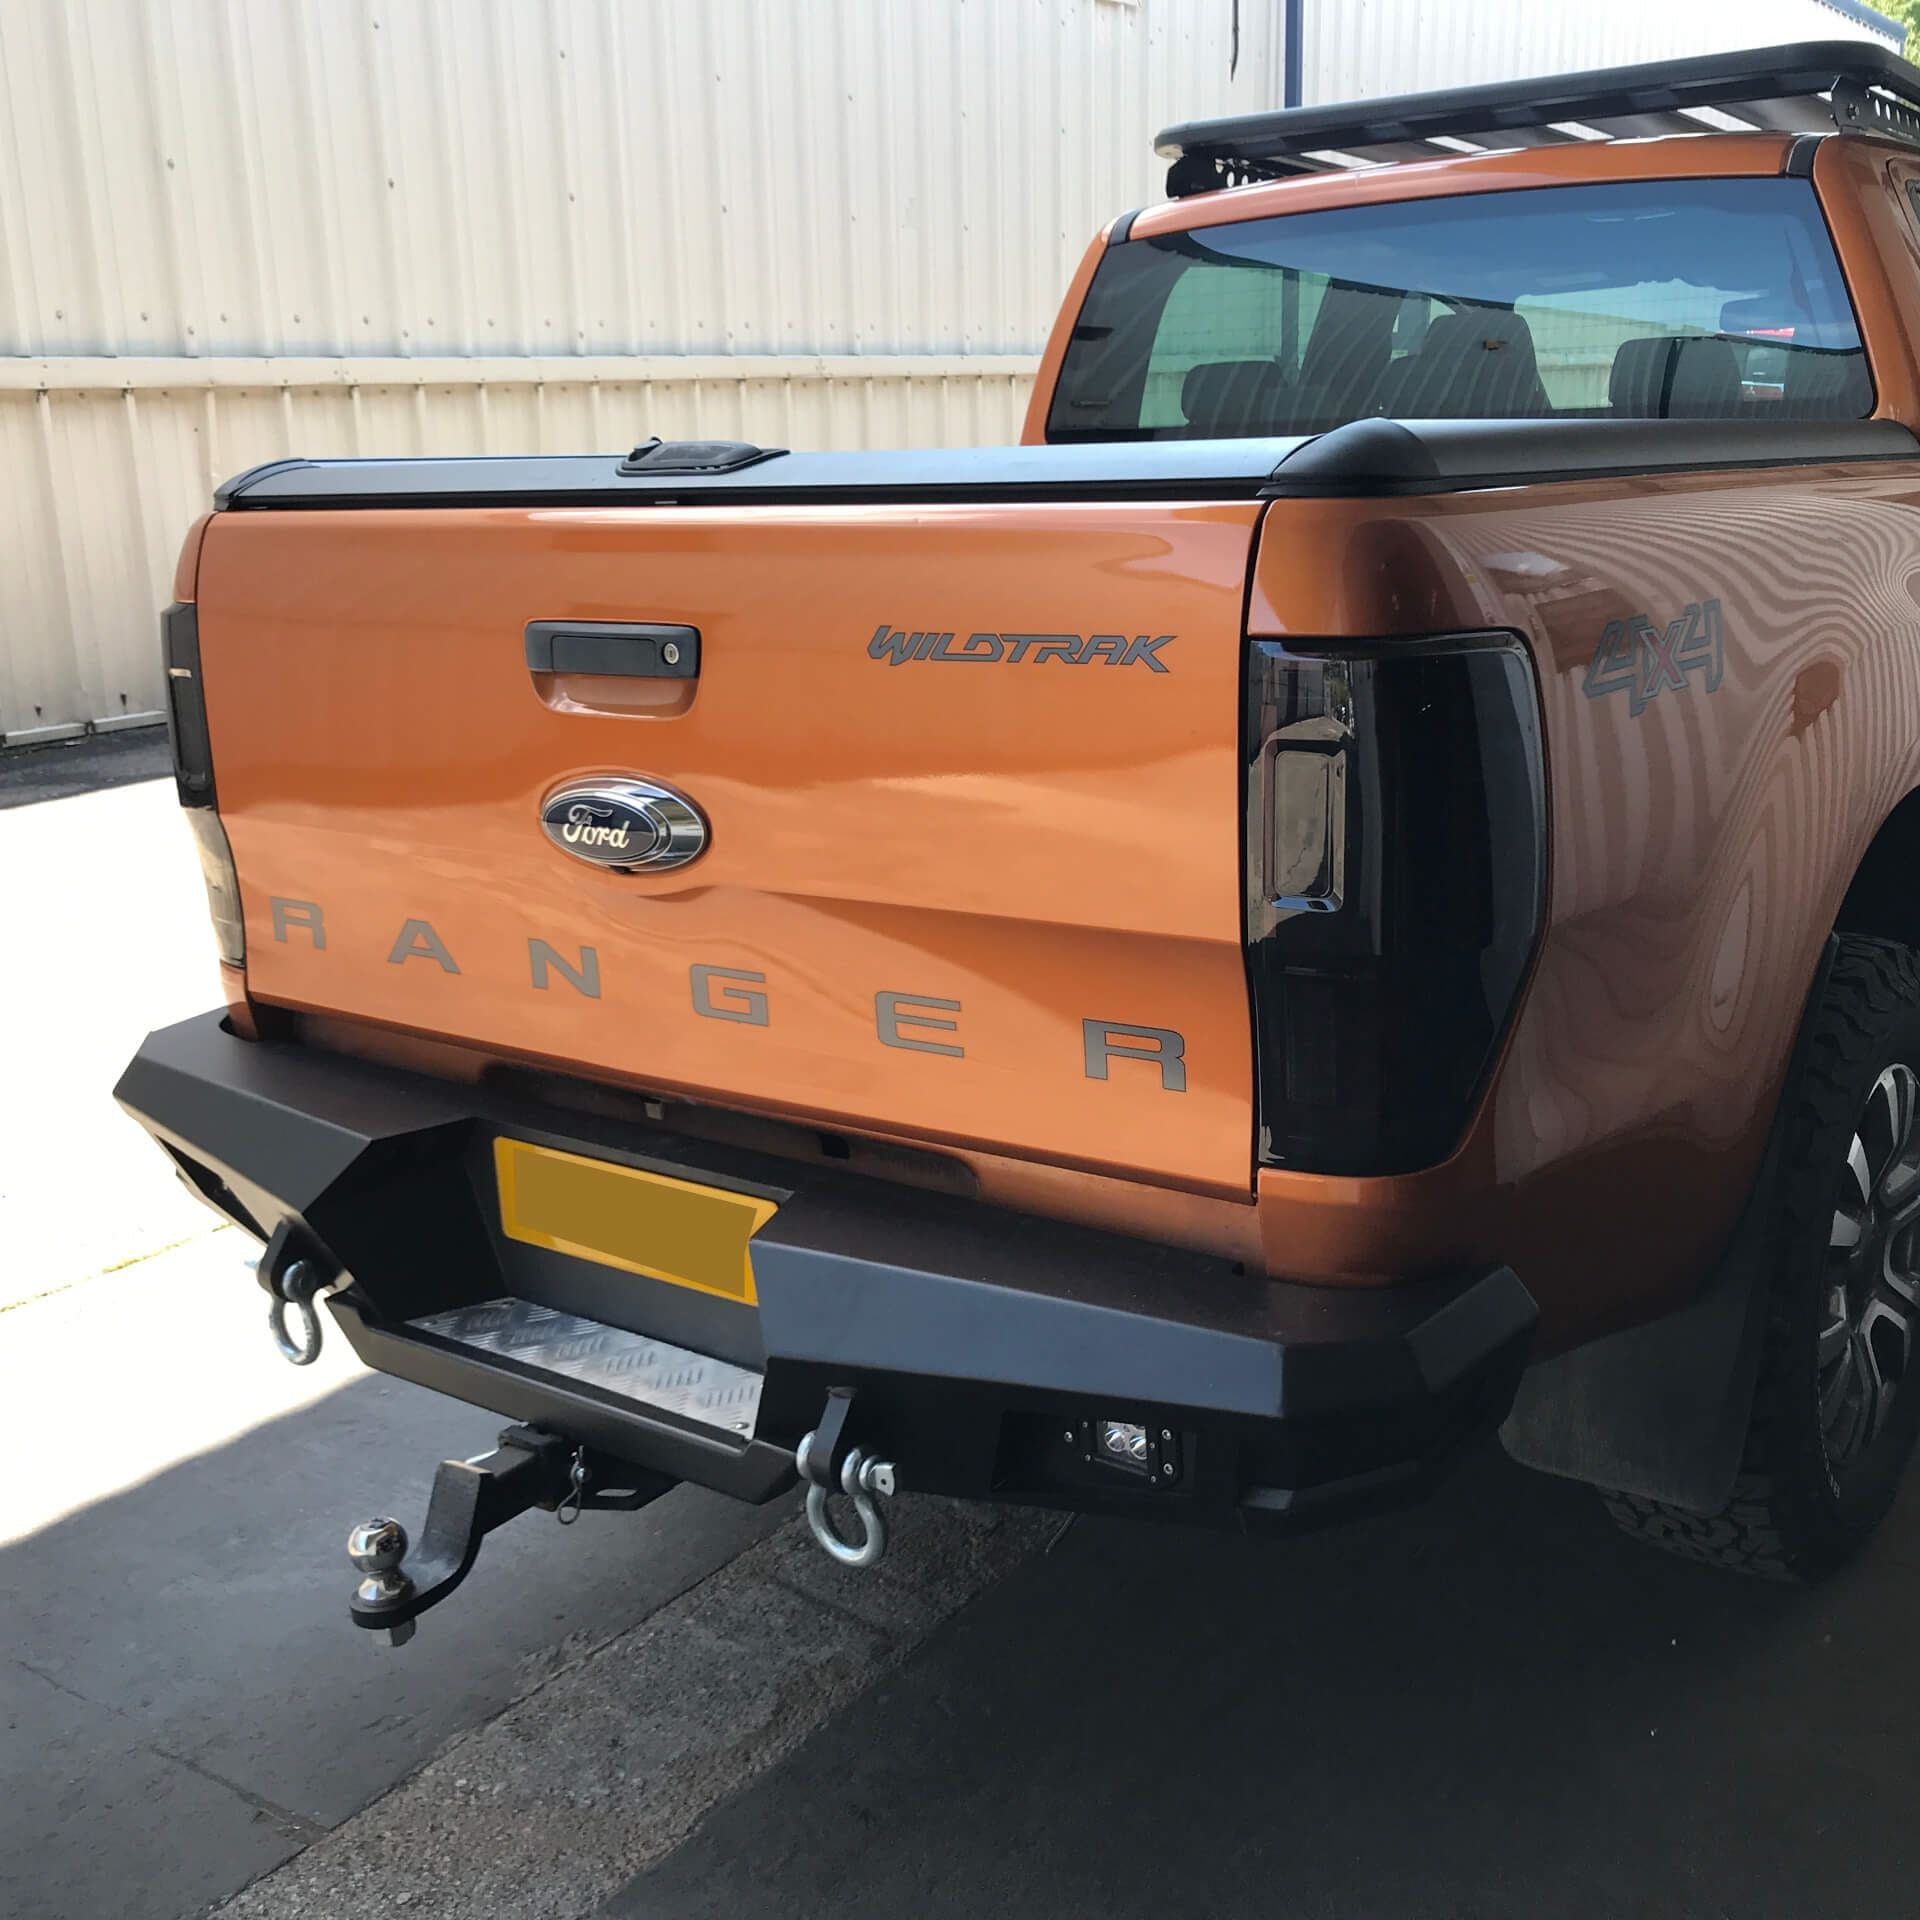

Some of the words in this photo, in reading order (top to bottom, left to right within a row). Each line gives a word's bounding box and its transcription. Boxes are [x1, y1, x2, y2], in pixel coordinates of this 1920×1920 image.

[866, 625, 1177, 673] WILDTRAK
[562, 803, 631, 849] Ford
[271, 897, 1188, 1093] RANGER
